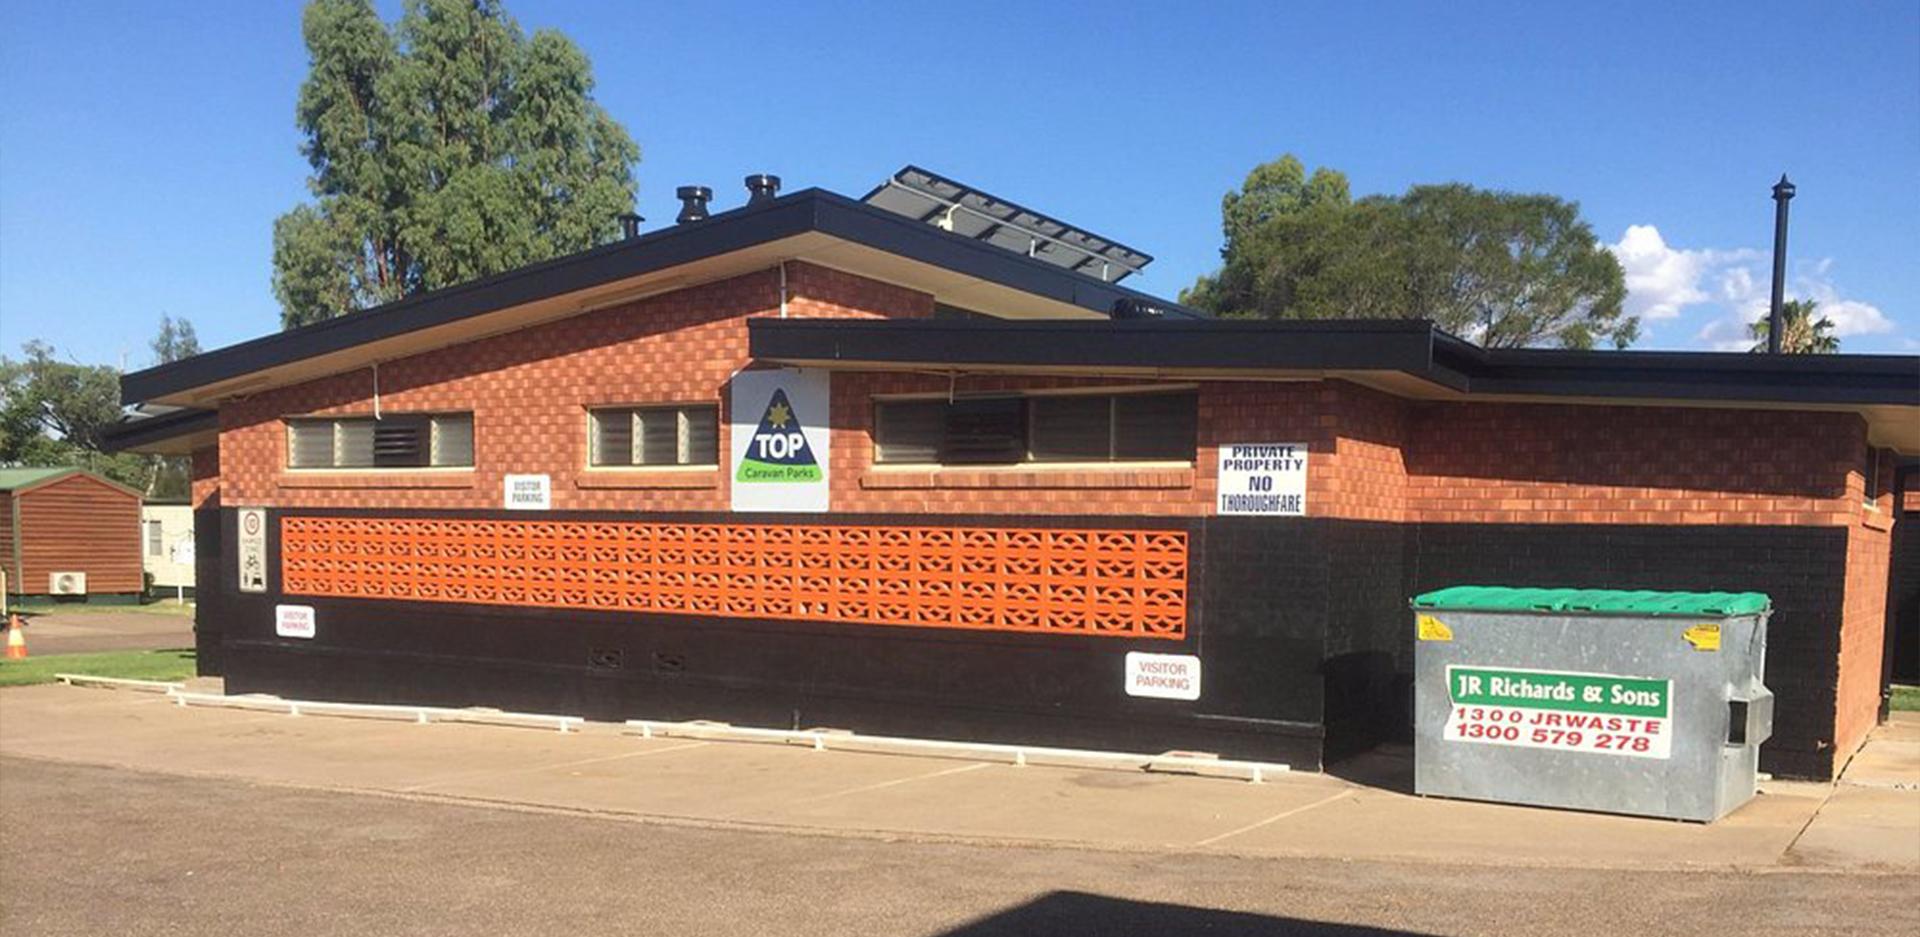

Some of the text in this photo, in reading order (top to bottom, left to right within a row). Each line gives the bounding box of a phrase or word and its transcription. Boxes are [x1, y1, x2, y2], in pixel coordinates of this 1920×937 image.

[756, 433, 804, 459] TOP
[1232, 445, 1295, 458] PRIVATE
[745, 466, 814, 479] Caravan Parks
[1223, 459, 1303, 471] PROPERTY
[1249, 475, 1272, 492] NO
[512, 492, 543, 503] PARKING
[1221, 494, 1302, 513] THOROUGHFARE
[1139, 661, 1188, 675] VISITOR
[1136, 674, 1190, 690] PARKING
[1458, 675, 1660, 707] JR Richards & Sons
[1457, 707, 1661, 735] 1300 JRWASTE
[1457, 723, 1650, 752] 1300 579 278
